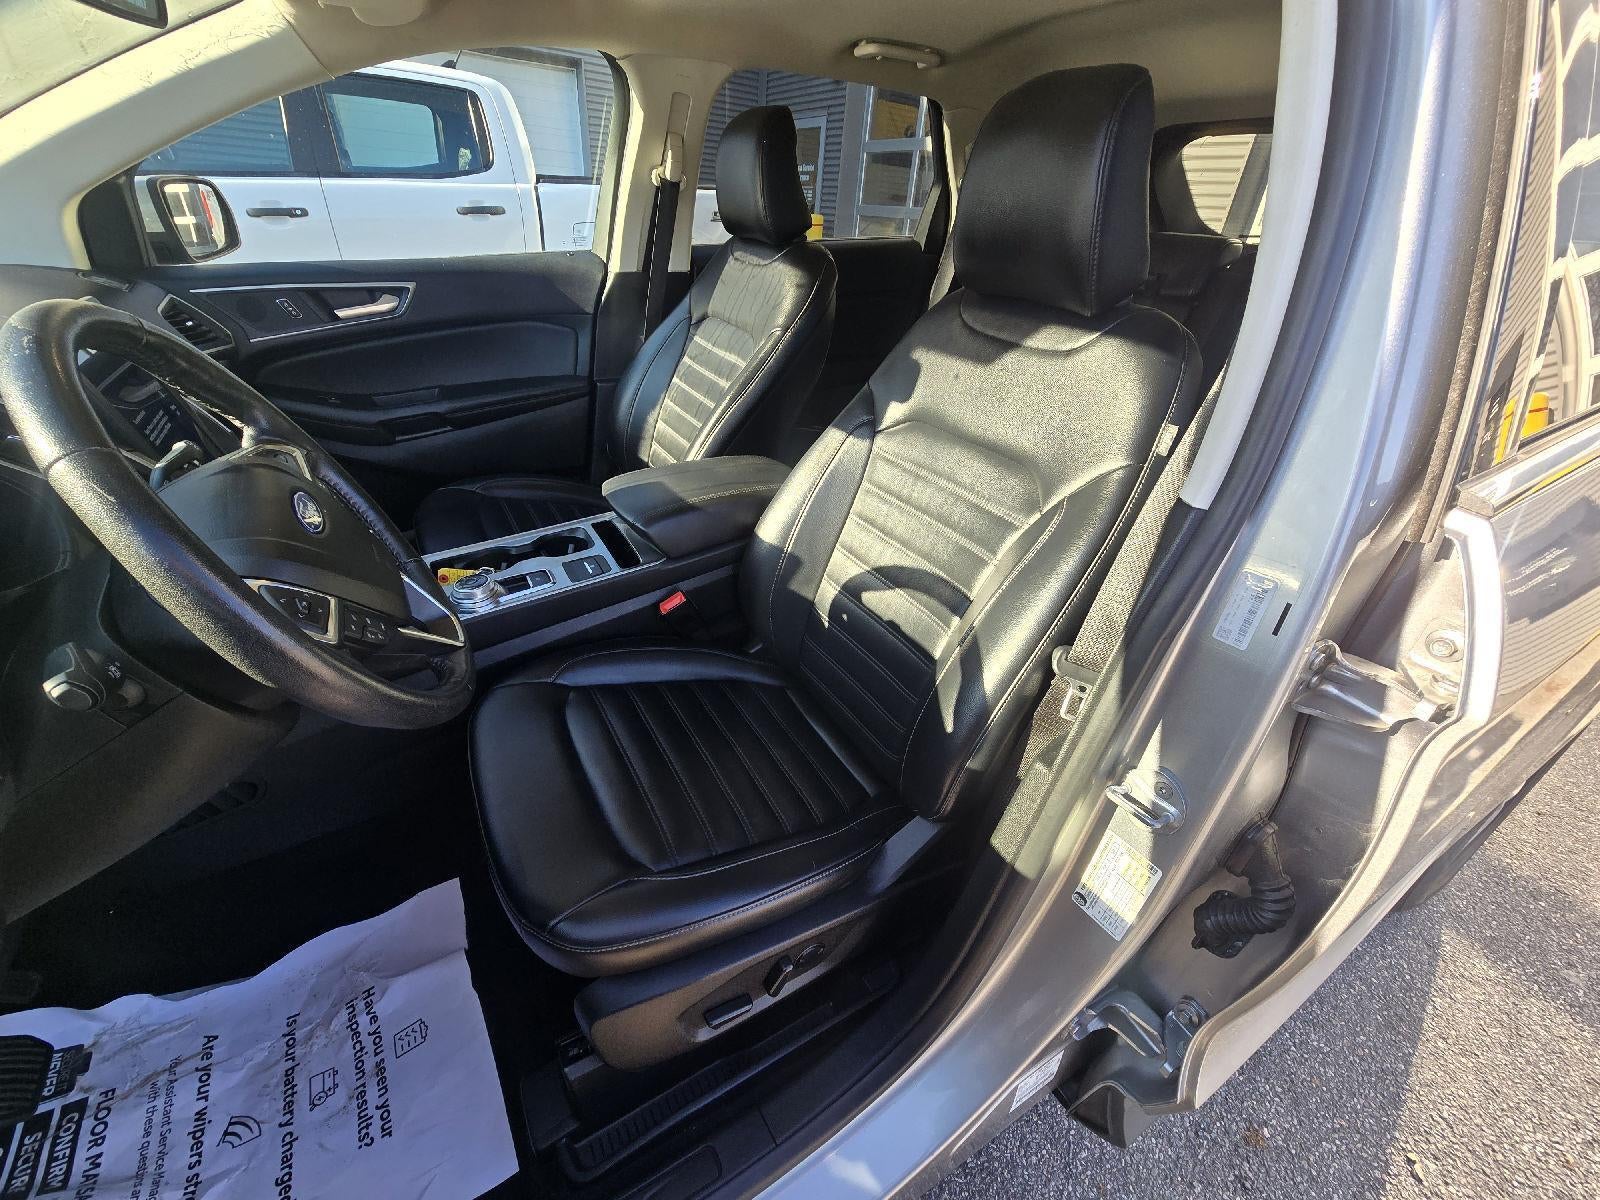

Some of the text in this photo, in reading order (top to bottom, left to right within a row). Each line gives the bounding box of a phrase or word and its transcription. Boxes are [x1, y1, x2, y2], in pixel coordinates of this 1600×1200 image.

[286, 1012, 300, 1028] Is
[168, 1054, 183, 1077] Your
[200, 1034, 219, 1061] Are
[282, 1028, 297, 1062] your
[361, 985, 393, 1139] Have you seen your
[147, 1080, 161, 1104] with
[194, 1062, 213, 1103] your
[278, 1062, 300, 1128] battery
[345, 997, 375, 1150] inspection results?
[86, 1088, 116, 1152] FLOOR
[142, 1105, 158, 1139] these
[161, 1078, 179, 1128] Assistant
[45, 1112, 79, 1190] CONFIRM
[154, 1127, 172, 1171] Service
[187, 1106, 212, 1171] wipers
